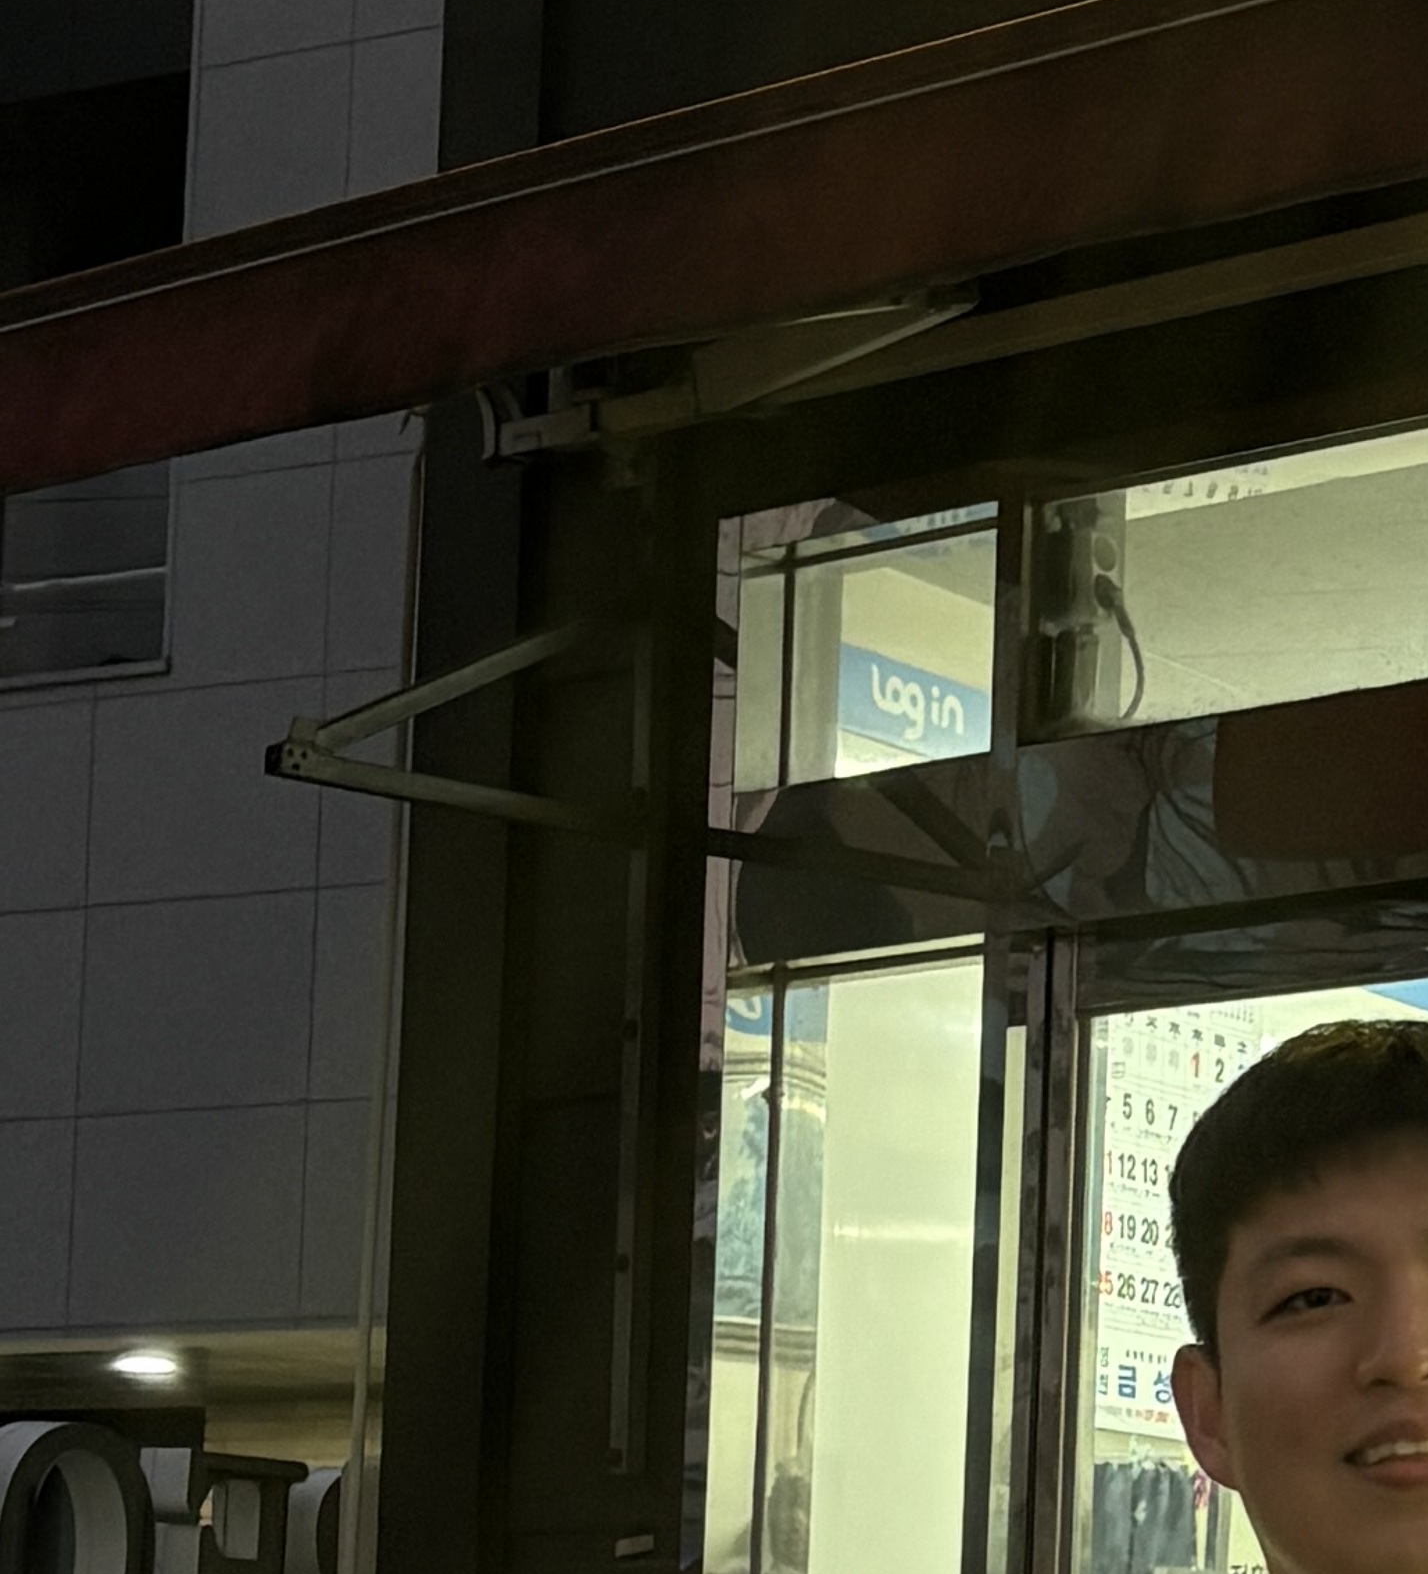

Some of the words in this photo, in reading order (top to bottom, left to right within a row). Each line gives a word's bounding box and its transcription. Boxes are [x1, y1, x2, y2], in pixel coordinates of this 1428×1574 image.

[1190, 1051, 1200, 1079] 1
[1215, 1057, 1225, 1083] 2
[1122, 1092, 1132, 1120] 5
[1145, 1098, 1155, 1125] 6
[1168, 1104, 1178, 1131] 7
[1118, 1152, 1136, 1181] 12
[1141, 1157, 1158, 1186] 13
[1118, 1214, 1136, 1241] 19
[1141, 1218, 1159, 1246] 20
[1117, 1273, 1136, 1301] 26
[1141, 1277, 1159, 1305] 27
